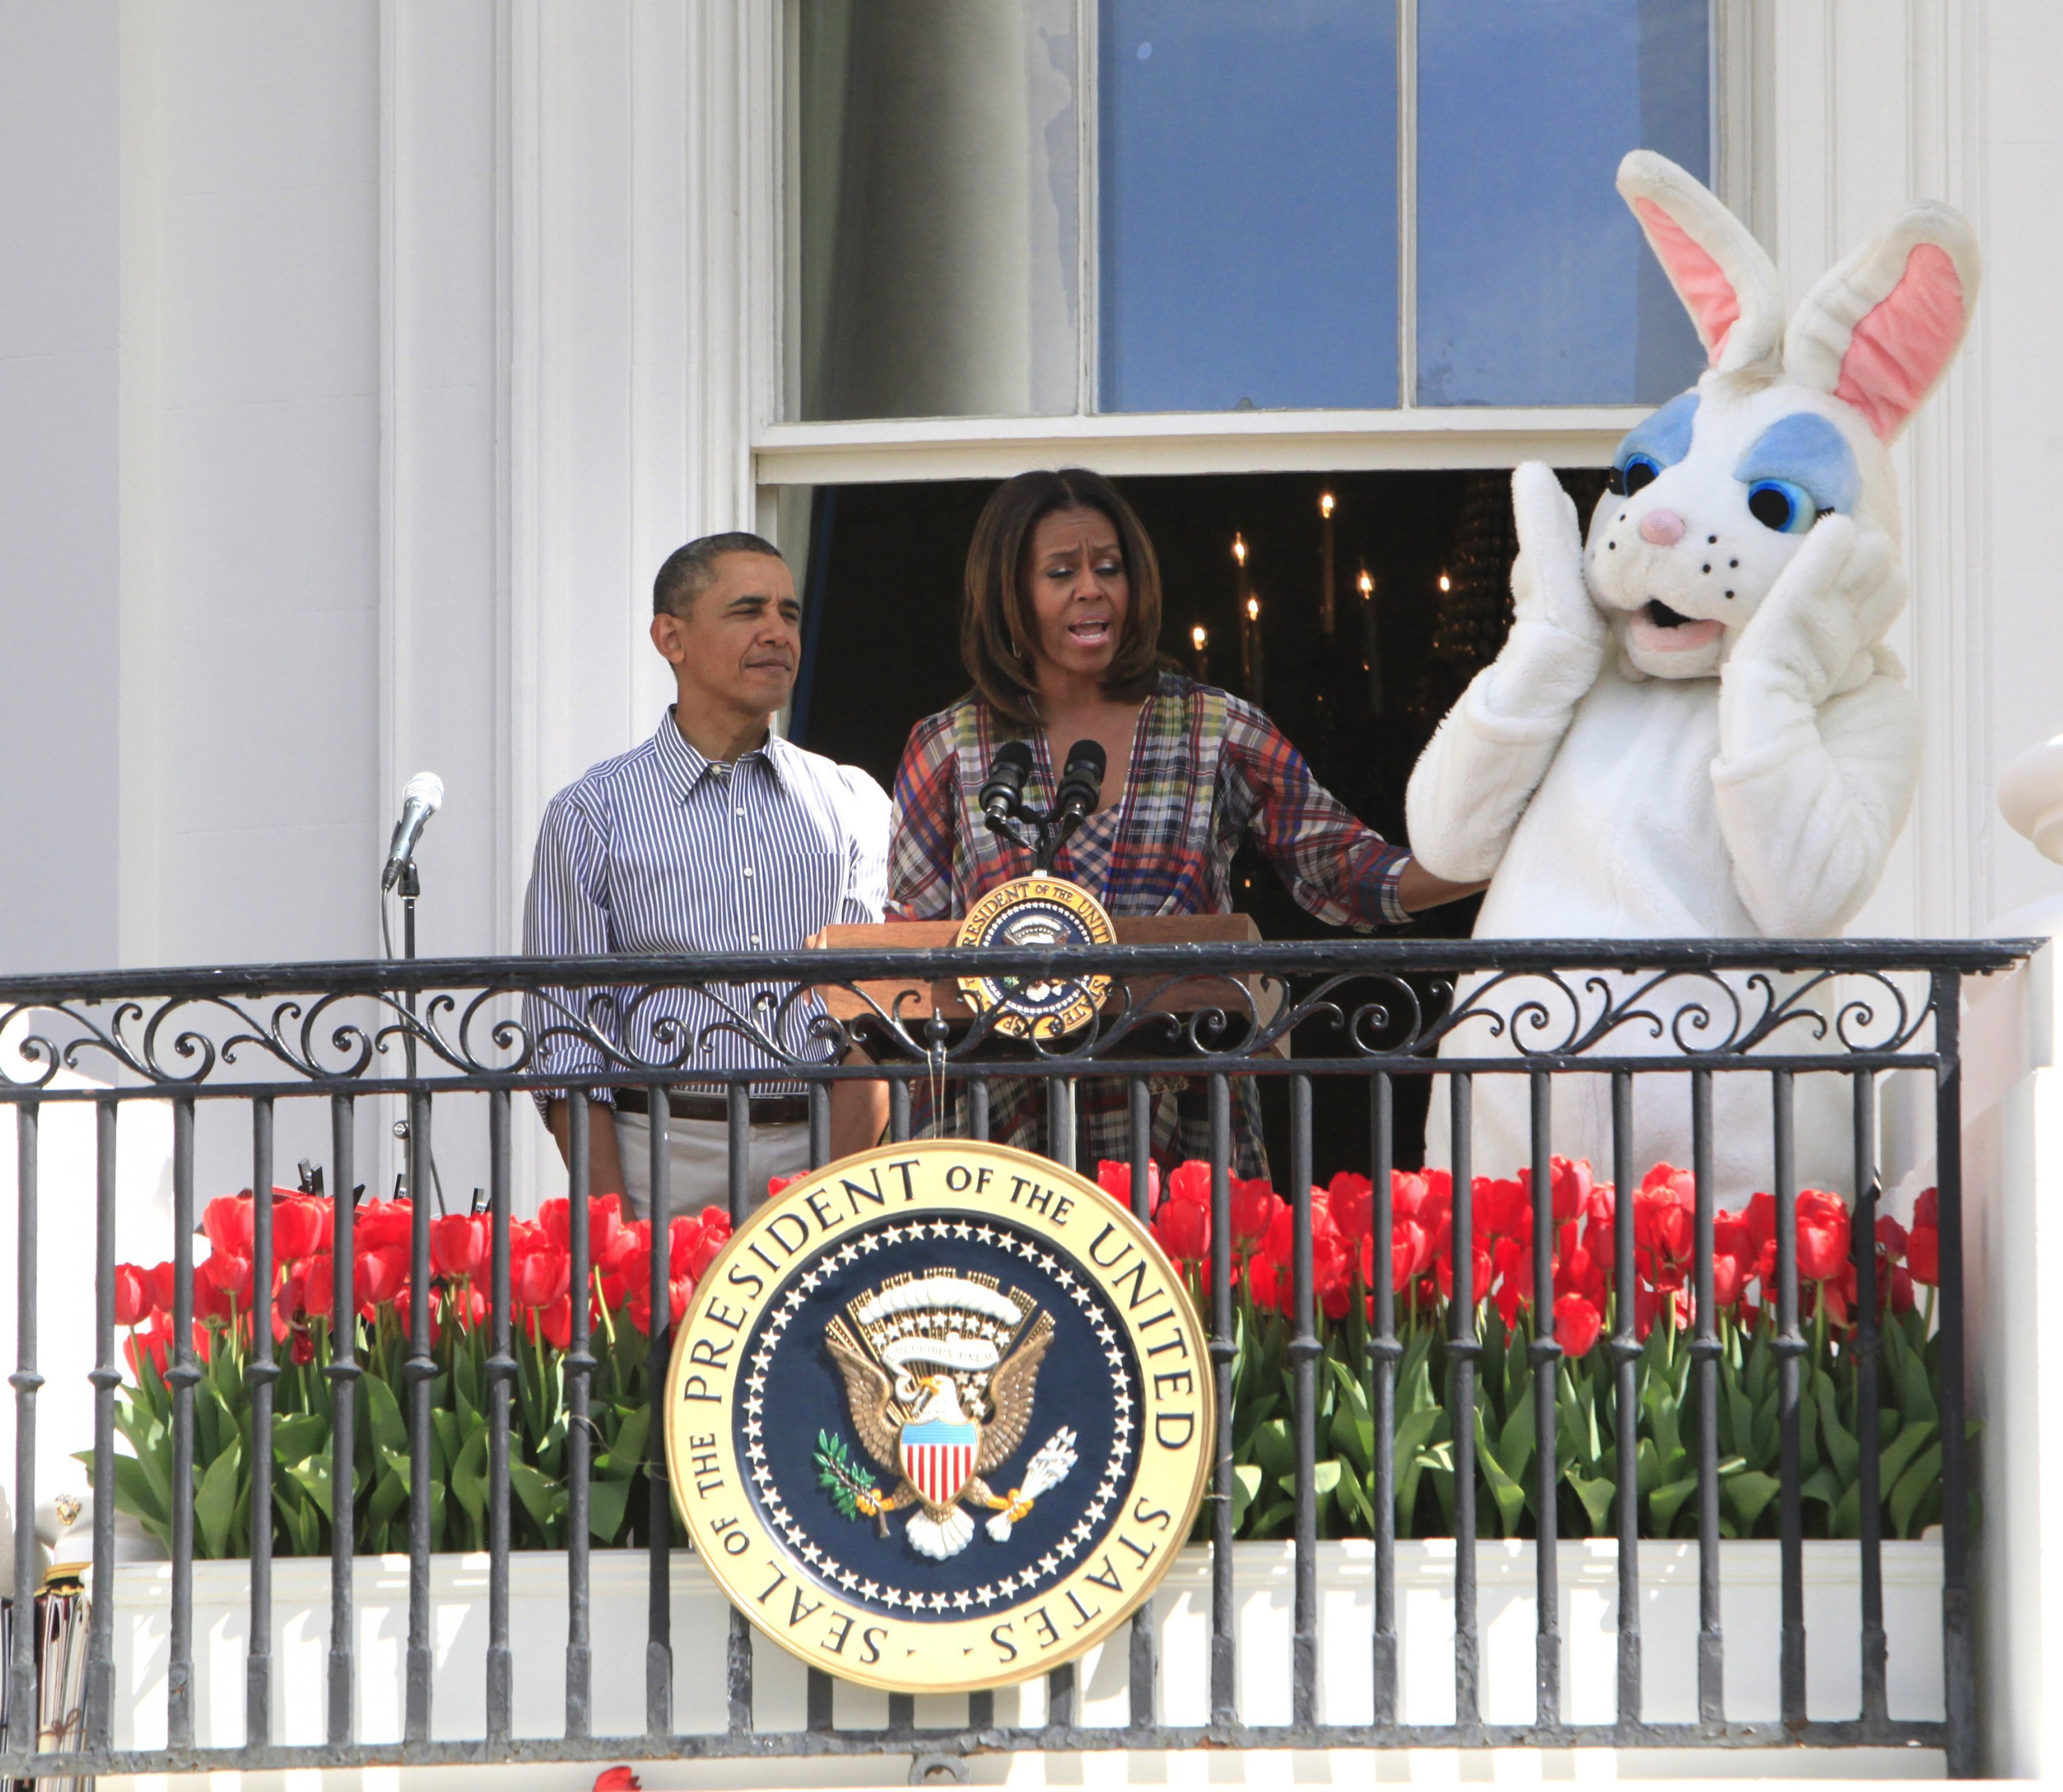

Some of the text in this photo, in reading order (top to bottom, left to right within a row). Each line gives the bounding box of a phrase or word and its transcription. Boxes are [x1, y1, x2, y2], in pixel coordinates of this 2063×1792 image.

[963, 883, 1029, 947] RESIDENT
[1036, 884, 1049, 895] OF
[1054, 887, 1073, 902] THE
[895, 1344, 952, 1359] PLURIBUS
[959, 1351, 993, 1363] UNUM
[685, 1159, 1195, 1665] SEAL OF THE PRESIDENT OF THE UNITED STATES
